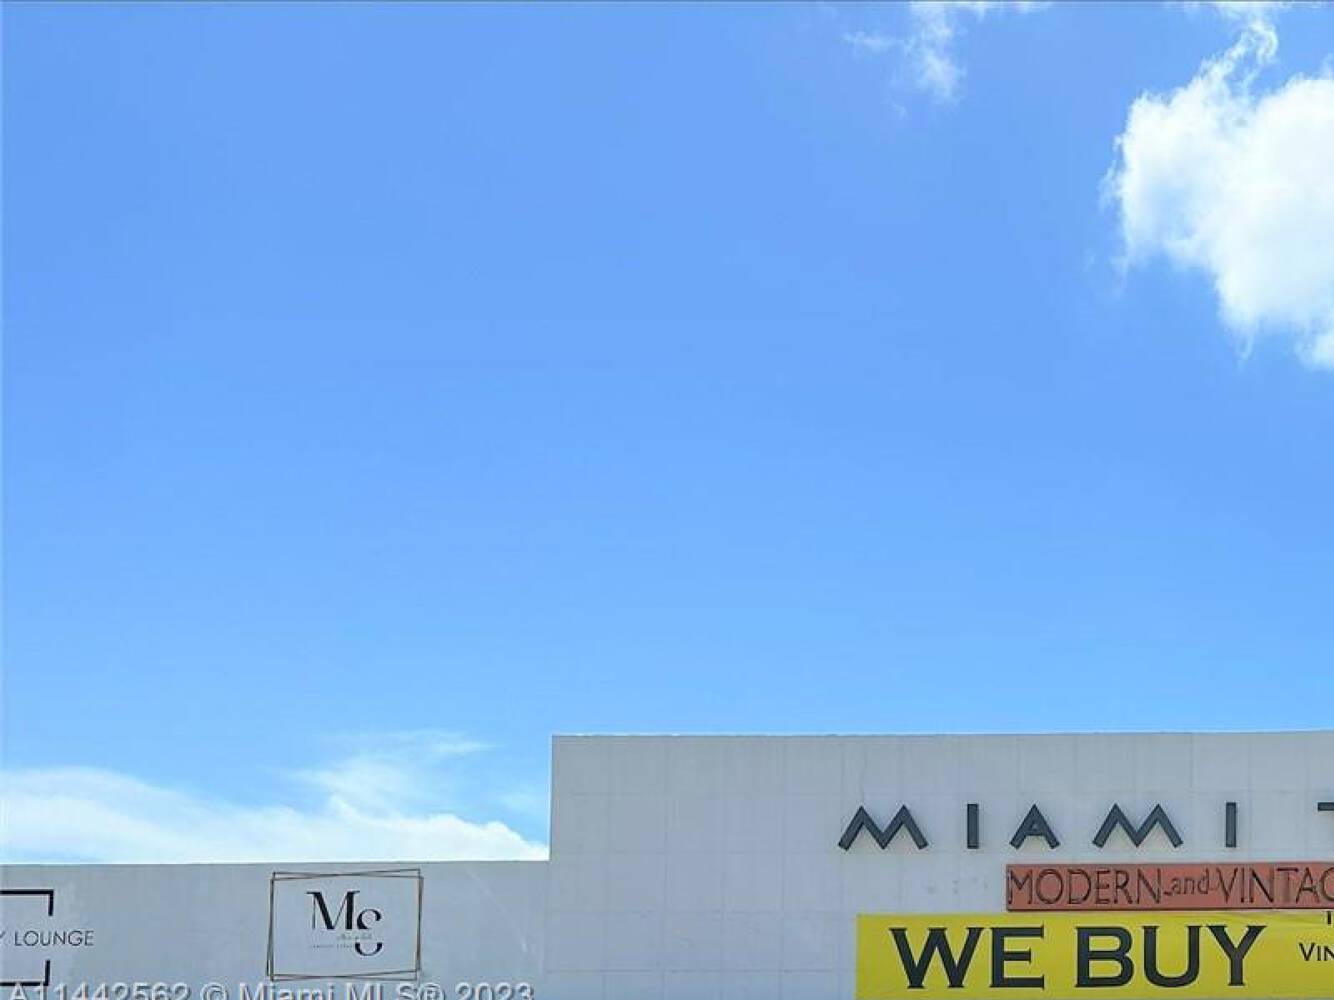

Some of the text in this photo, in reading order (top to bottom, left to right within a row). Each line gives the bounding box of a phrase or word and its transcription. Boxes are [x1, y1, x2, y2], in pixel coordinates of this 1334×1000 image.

[838, 803, 1237, 851] MIAMI
[1007, 867, 1161, 905] MODERN
[14, 930, 94, 946] LOUNGE
[889, 924, 1267, 989] WE BUY
